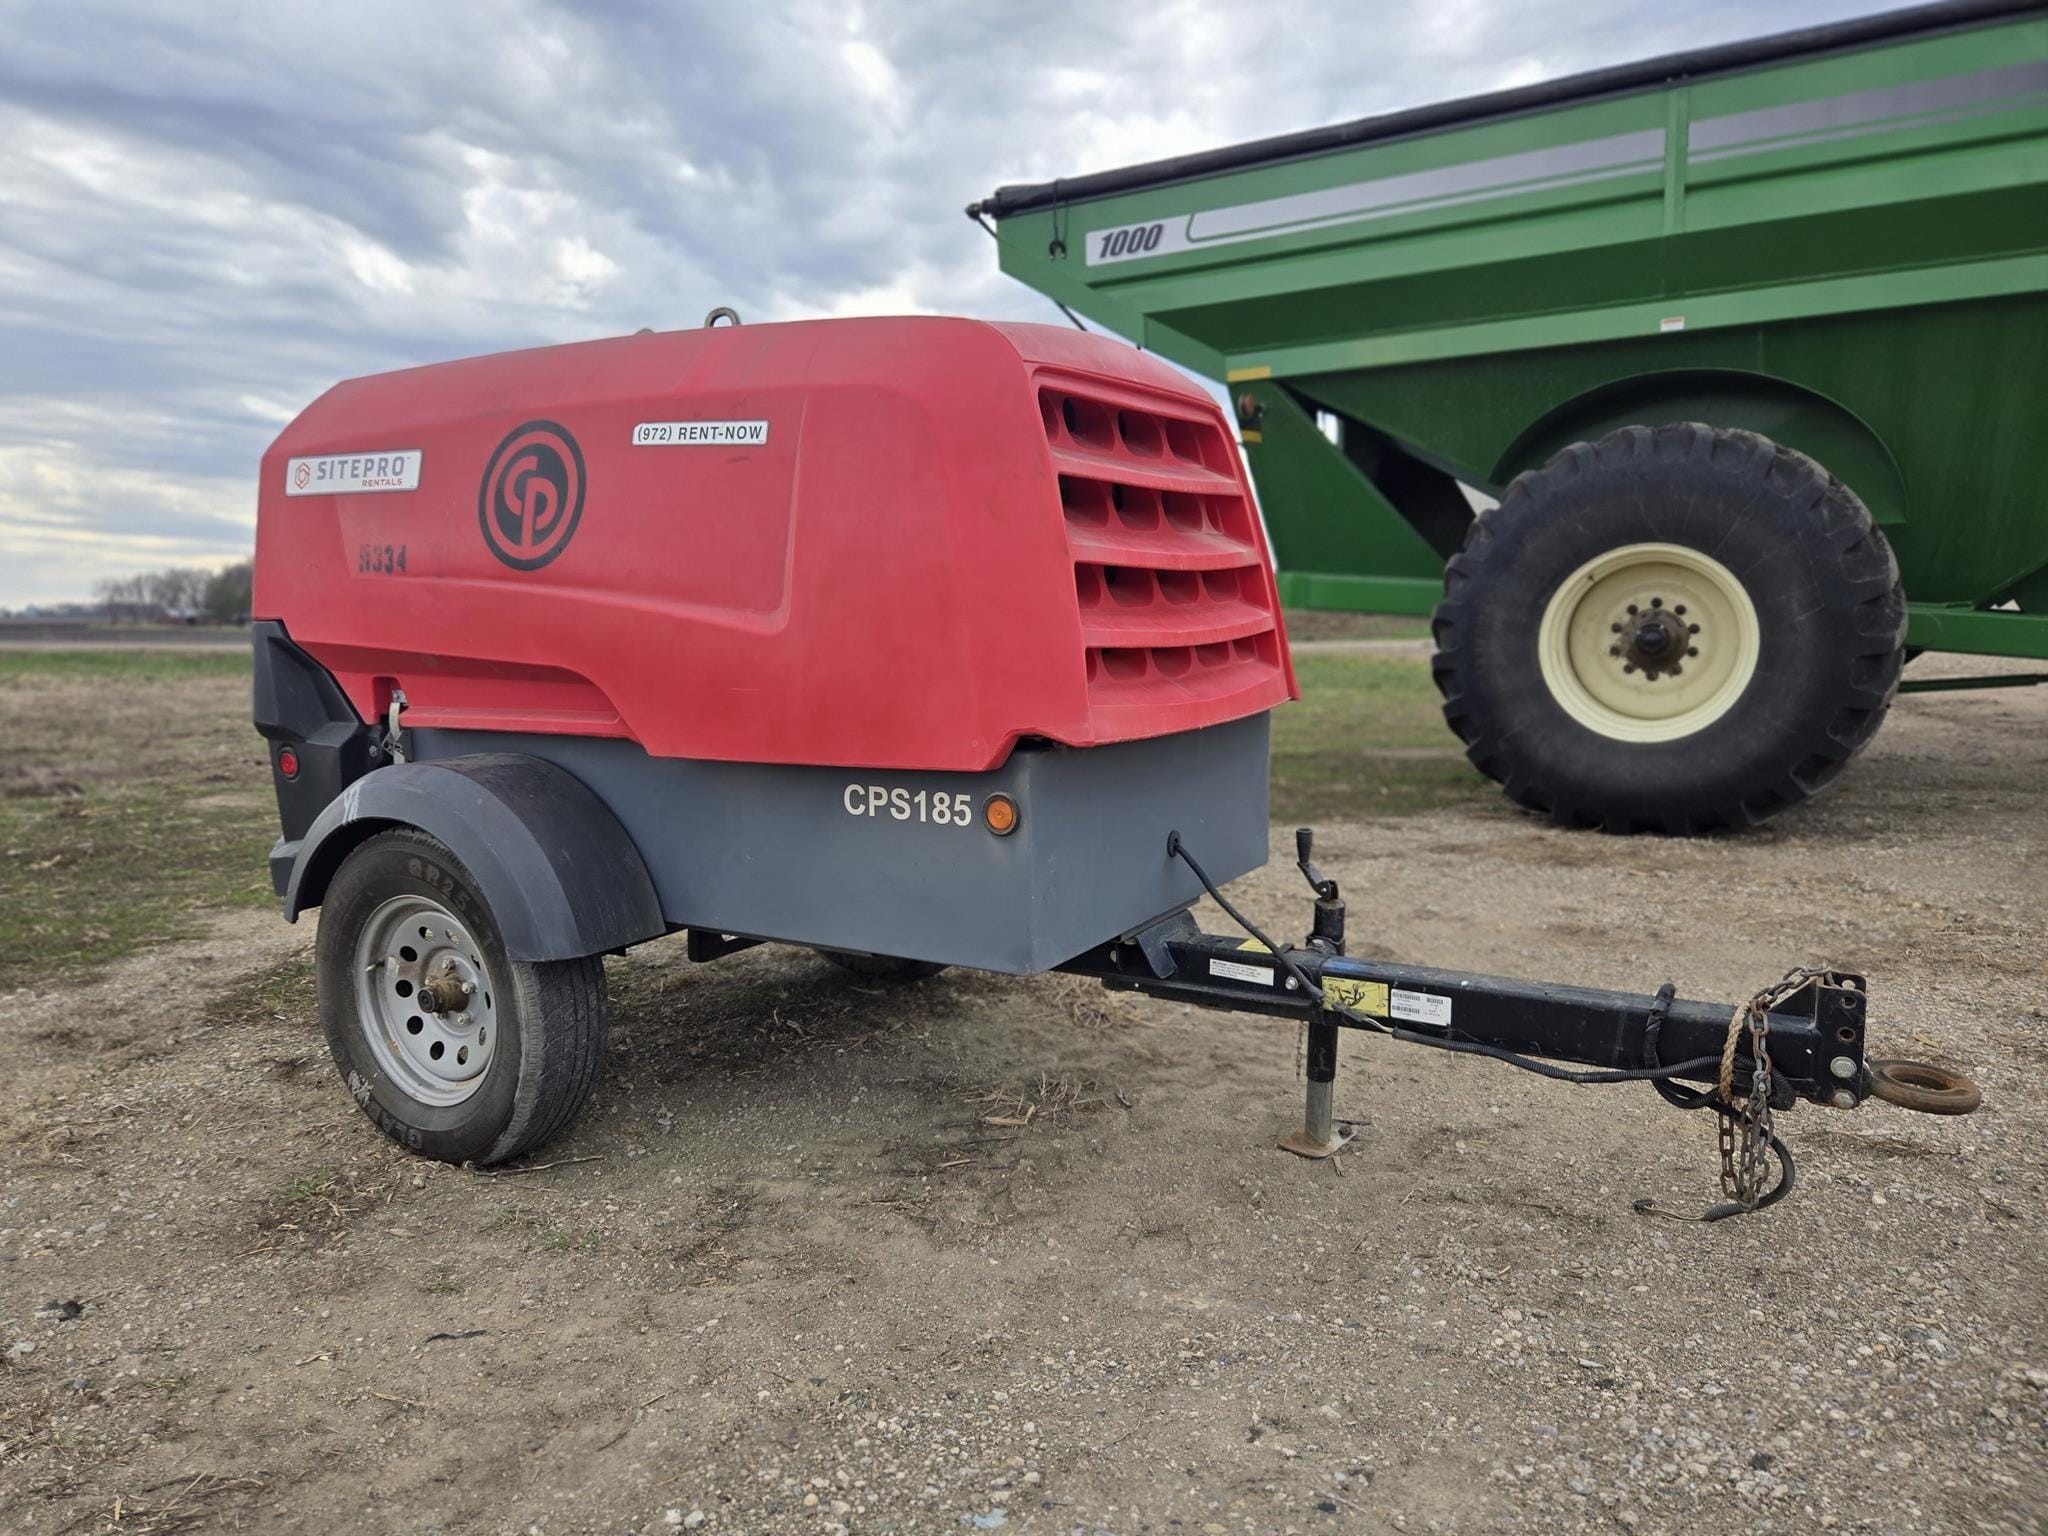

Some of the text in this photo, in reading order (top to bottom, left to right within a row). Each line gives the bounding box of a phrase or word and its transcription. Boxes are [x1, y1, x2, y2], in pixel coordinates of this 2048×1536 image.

[1099, 223, 1164, 258] 1000
[638, 425, 763, 442] (972) RENT-NOW
[317, 456, 405, 480] SITEPRO
[361, 478, 403, 488] RENTALS
[844, 783, 972, 827] CPS185
